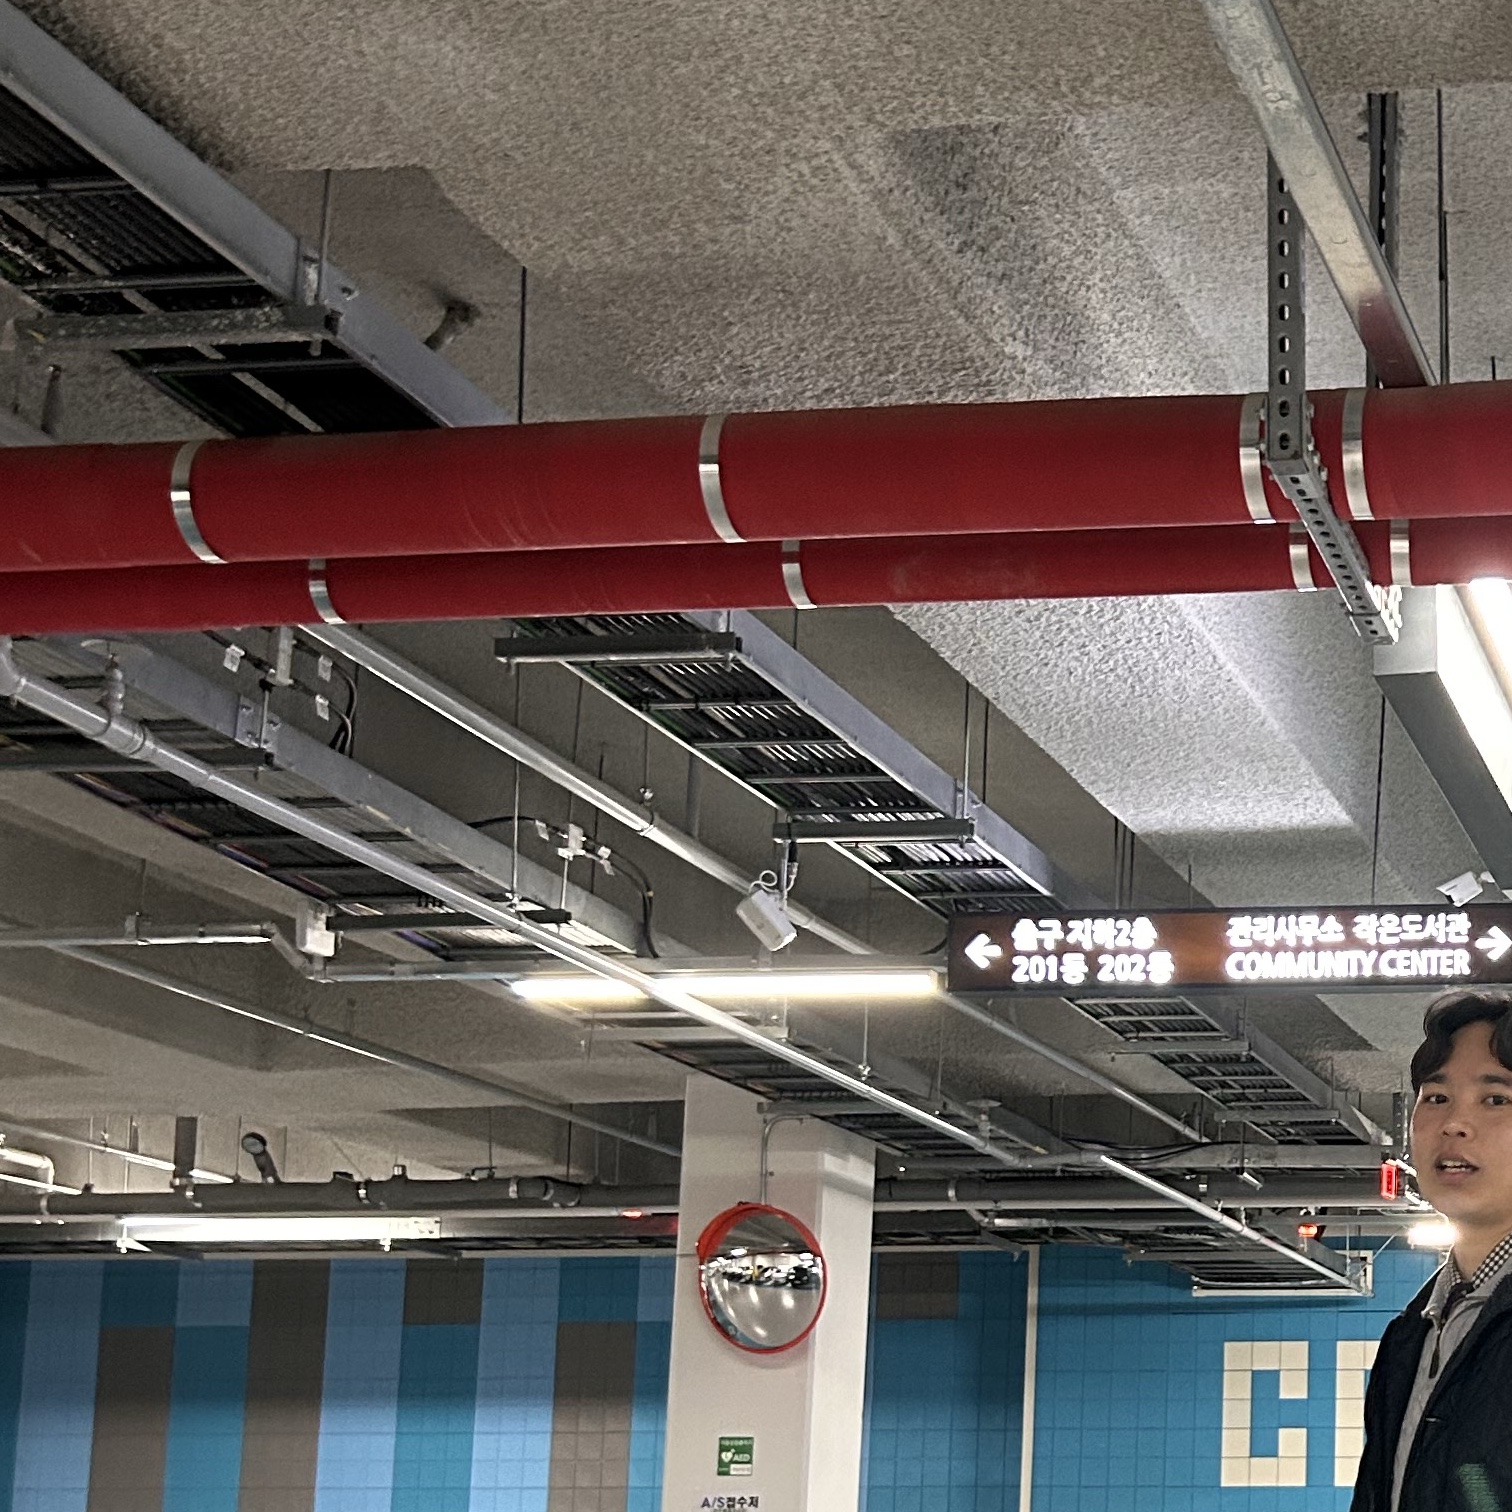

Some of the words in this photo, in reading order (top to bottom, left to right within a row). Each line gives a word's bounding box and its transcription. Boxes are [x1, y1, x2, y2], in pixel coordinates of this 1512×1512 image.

[1011, 952, 1089, 985] 201동
[1097, 951, 1175, 984] 202동
[1225, 949, 1378, 980] COMMUNITY
[1379, 948, 1471, 978] CENTER
